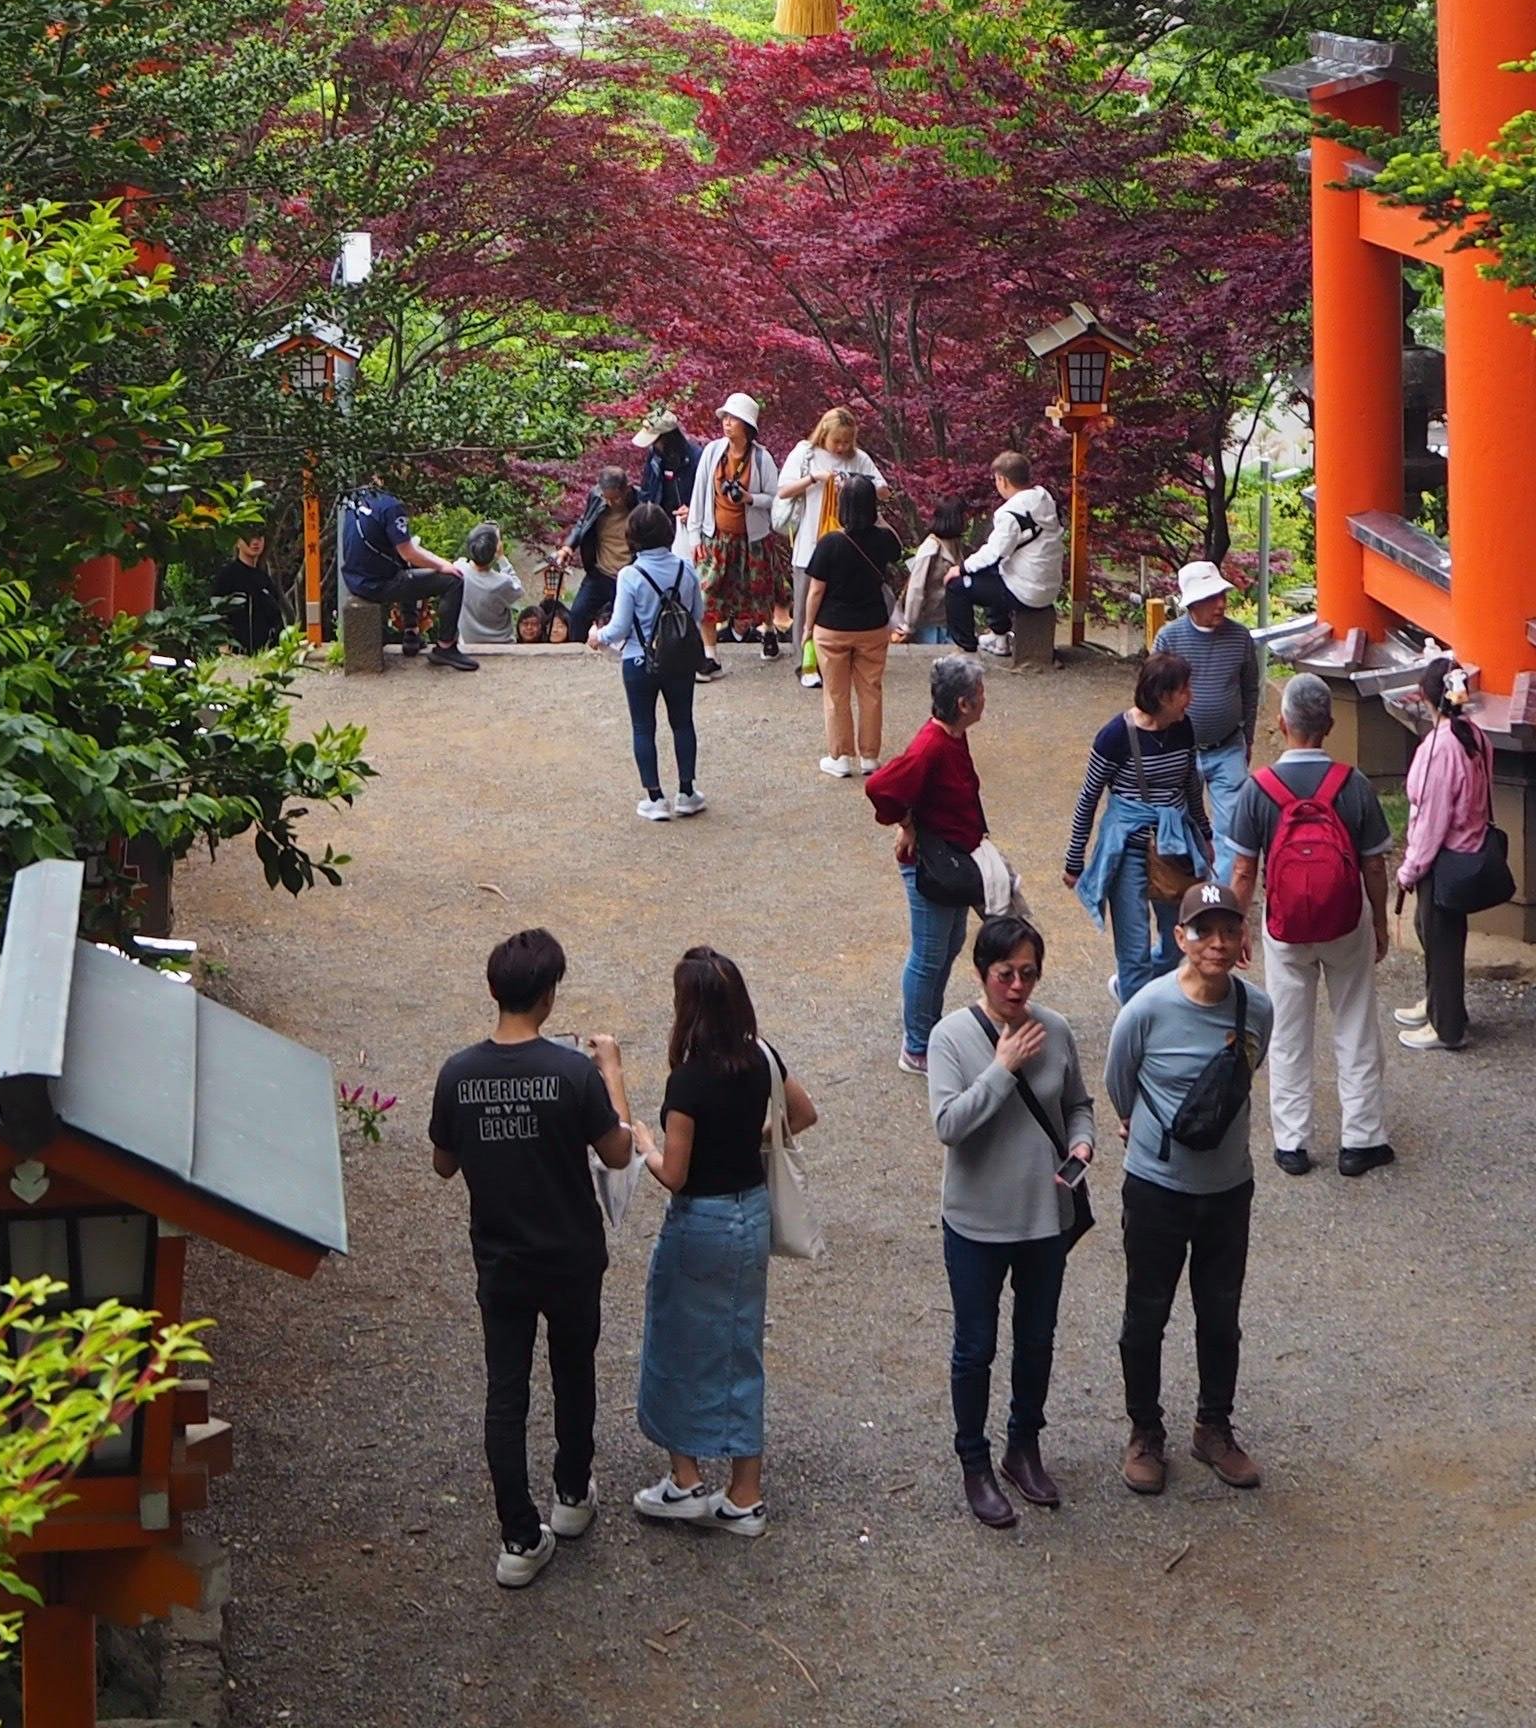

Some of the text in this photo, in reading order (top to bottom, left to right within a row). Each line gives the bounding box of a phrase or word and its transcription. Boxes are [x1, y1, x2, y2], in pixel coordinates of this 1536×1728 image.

[457, 1076, 560, 1104] AMERICAN
[485, 1104, 531, 1114] NYC USA
[479, 1115, 539, 1141] EAGLE
